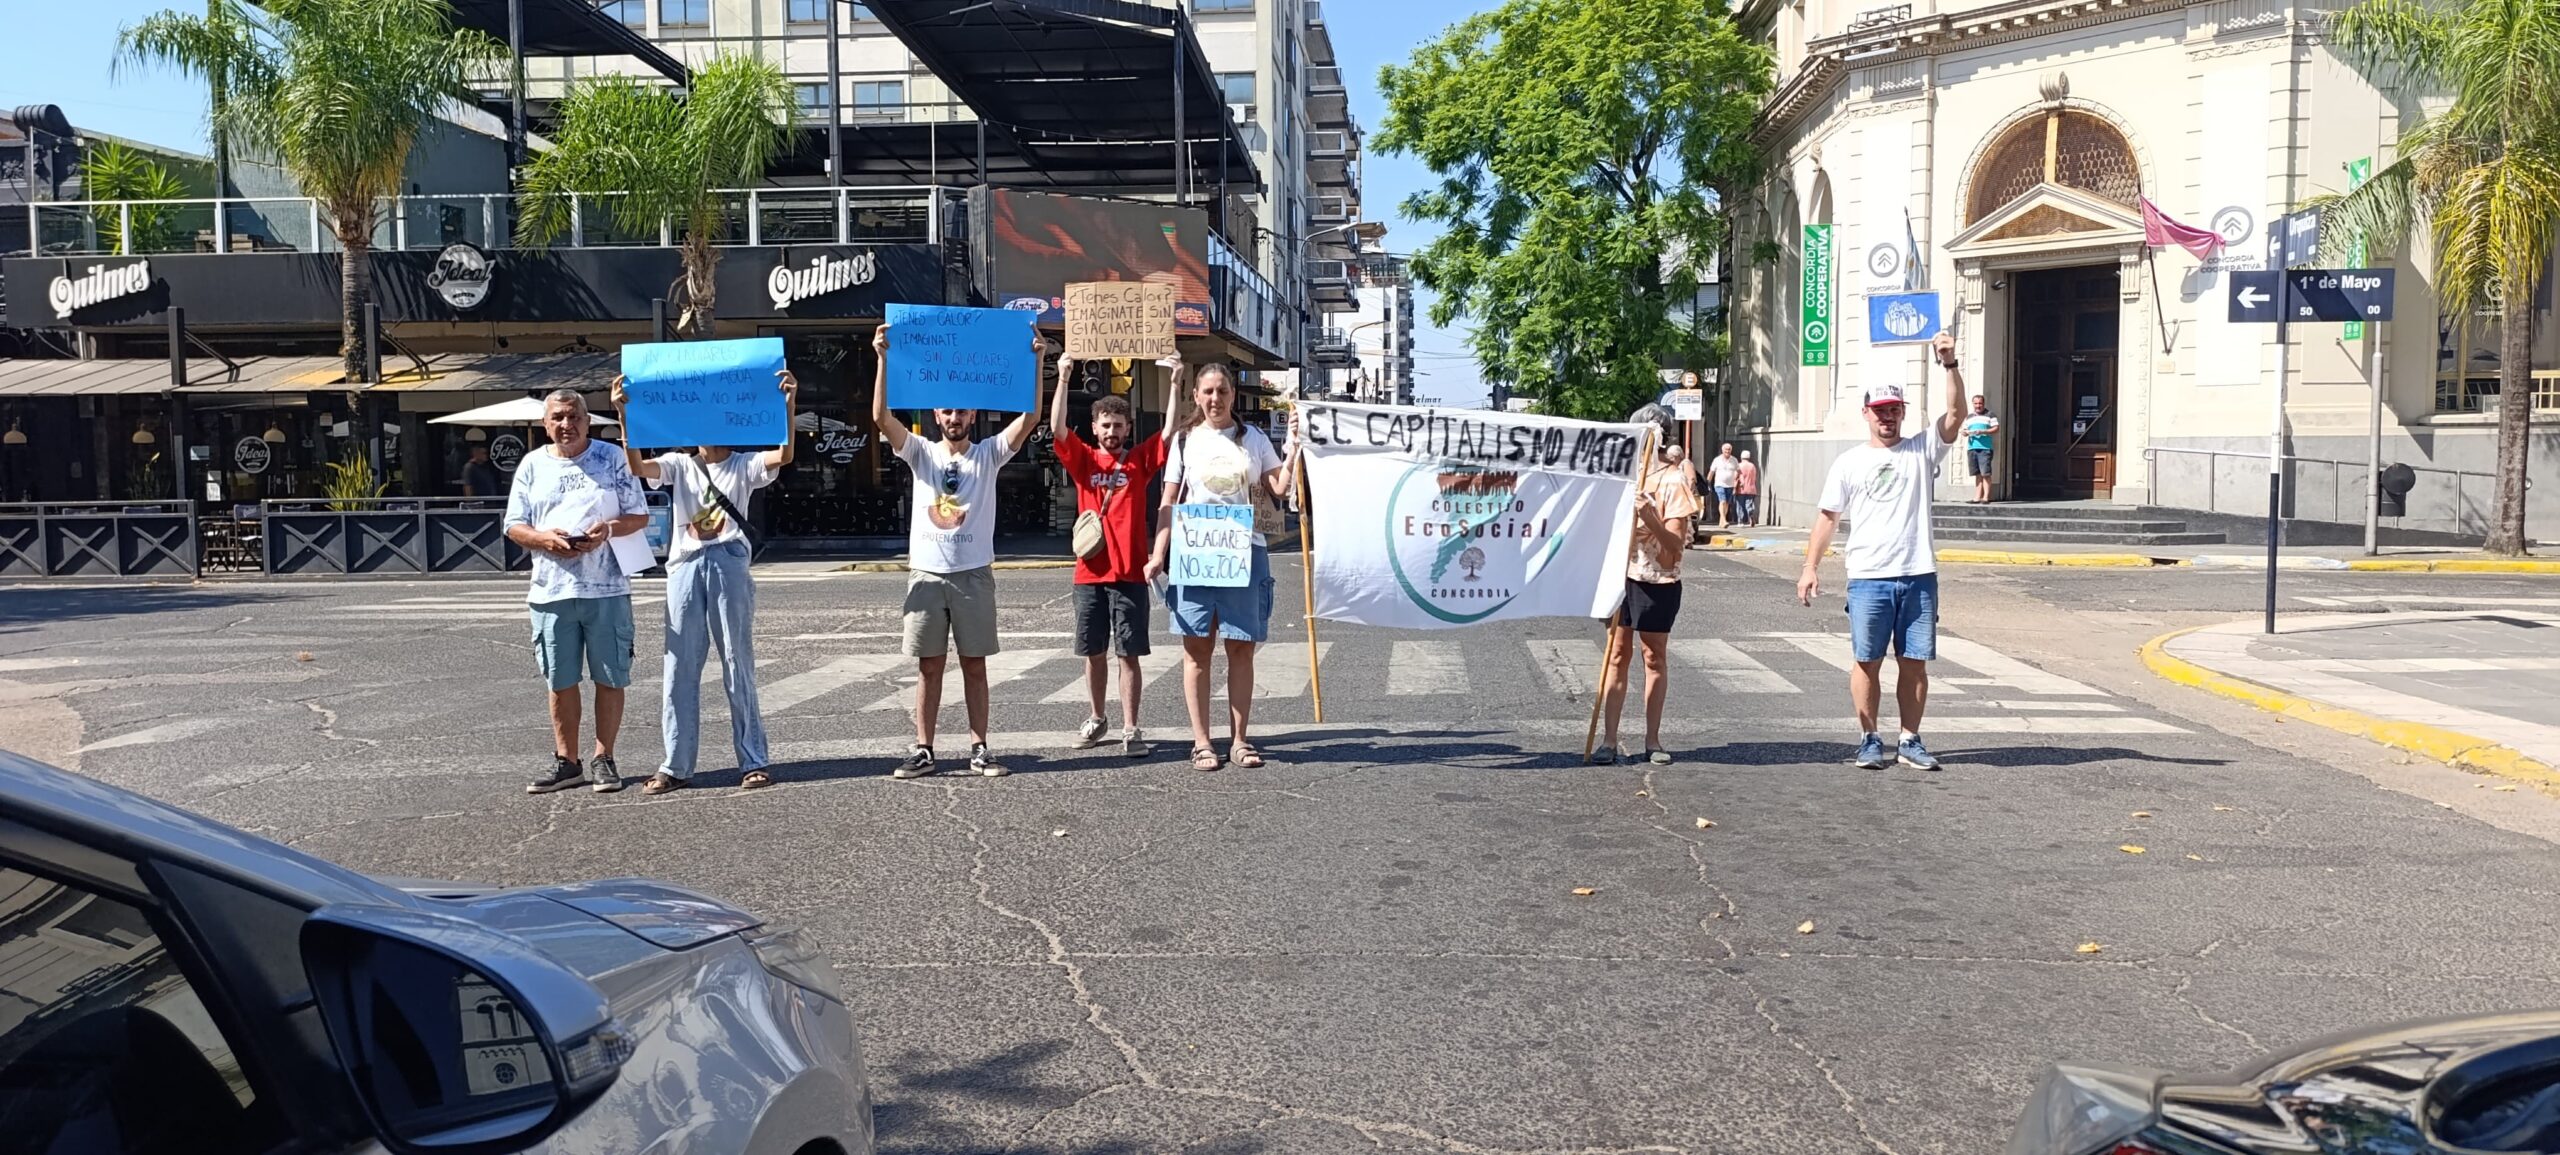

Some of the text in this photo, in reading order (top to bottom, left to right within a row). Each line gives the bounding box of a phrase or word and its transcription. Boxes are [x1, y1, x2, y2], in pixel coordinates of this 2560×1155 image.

[767, 252, 876, 310] Quilmes
[1806, 238, 1816, 307] CONCORDIA
[1817, 228, 1828, 317] COOPERATIVA
[49, 260, 150, 319] Quilmes
[2319, 277, 2337, 289] de
[2341, 275, 2381, 291] Mayo
[936, 310, 984, 327] CALOR?
[2300, 305, 2381, 316] 50 00
[1159, 321, 1167, 333] Y
[1071, 337, 1175, 355] SIN VACACIONES
[924, 350, 1010, 369] SIN GLACIARES
[654, 367, 753, 386] NO HAY AGUA
[906, 368, 914, 382] Y
[919, 367, 940, 383] SIN
[642, 391, 758, 405] SIN AGUA NO HAY
[816, 431, 868, 453] Ideal
[1306, 407, 1352, 445] EL
[1569, 427, 1637, 476] MATA
[490, 444, 520, 460] Idea
[1187, 504, 1202, 519] LA
[1206, 504, 1232, 521] LEY
[1404, 518, 1548, 538] EcoSocial
[1185, 529, 1253, 550] GLACIARES
[1179, 554, 1200, 579] NO
[1216, 554, 1250, 579] TOCA
[1431, 588, 1510, 598] CONCORDIA
